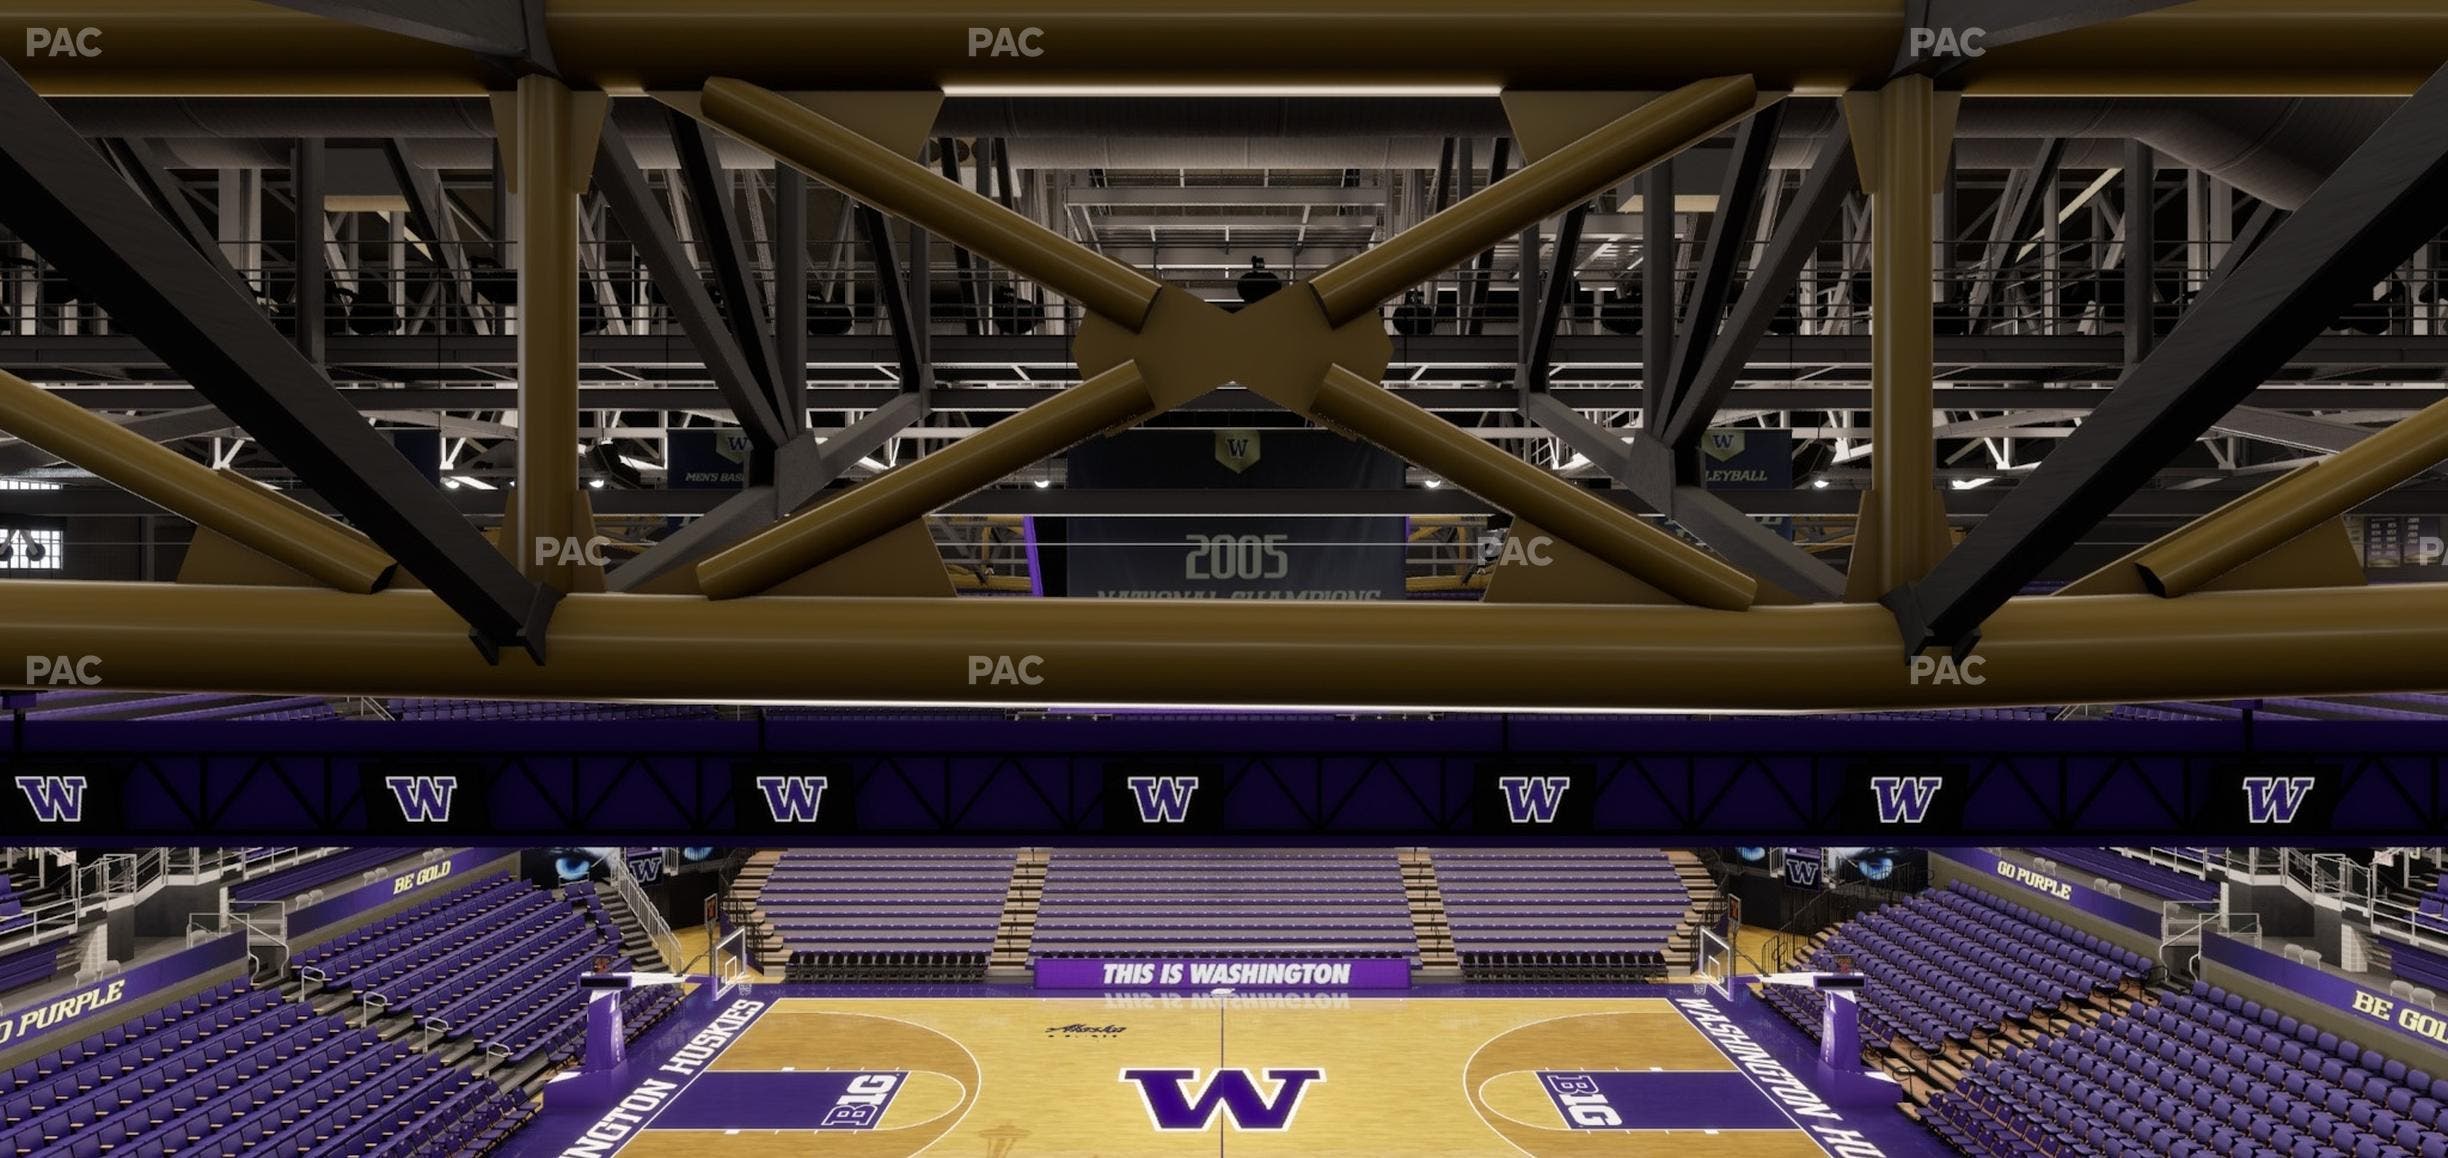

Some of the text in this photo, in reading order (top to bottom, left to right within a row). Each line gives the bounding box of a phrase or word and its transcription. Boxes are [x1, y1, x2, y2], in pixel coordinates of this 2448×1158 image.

[1225, 438, 1248, 459] W
[1712, 435, 1734, 448] W
[685, 472, 744, 482] MEN'S BAS
[1185, 534, 1288, 580] 2005
[15, 776, 87, 823] W
[385, 776, 457, 823] W
[756, 776, 828, 823] W
[1128, 776, 1200, 823] W
[1499, 776, 1570, 823] W
[1870, 776, 1942, 823] W
[2242, 776, 2315, 823] W
[393, 860, 451, 895] BE GOLD
[630, 858, 662, 883] W
[1786, 859, 1819, 885] W
[1997, 861, 2072, 900] GO PURPLE
[1103, 963, 1351, 985] THIS IS WASHINGTON
[16, 979, 125, 1037] PURPLE
[2352, 990, 2394, 1021] BE
[558, 1078, 678, 1158] NGTON
[659, 999, 766, 1076] HUSKIES
[1675, 998, 1844, 1121] WASHINGTON
[1118, 1067, 1327, 1133] W
